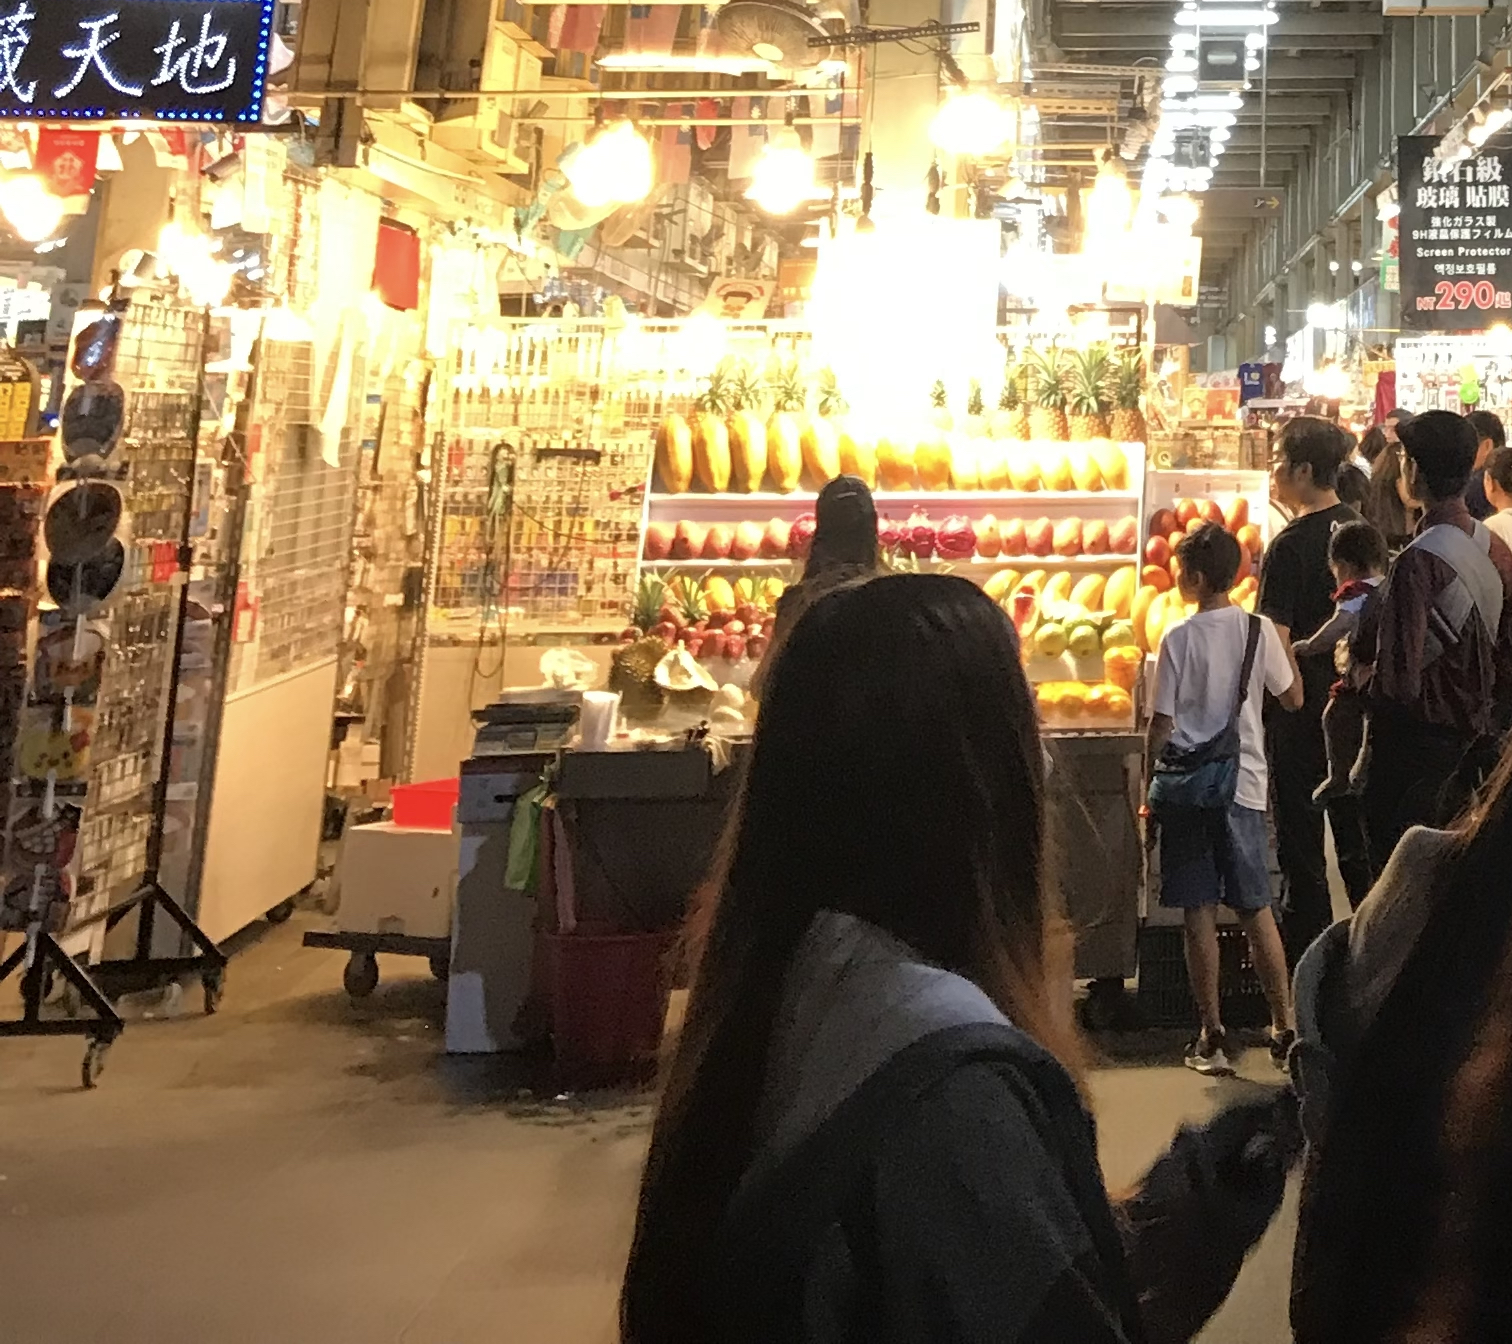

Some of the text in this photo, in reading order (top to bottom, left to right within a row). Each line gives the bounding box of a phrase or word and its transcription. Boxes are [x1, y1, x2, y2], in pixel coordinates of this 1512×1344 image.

[1416, 184, 1511, 209] 玻璃 貼膜
[1416, 246, 1512, 258] Screen Protector
